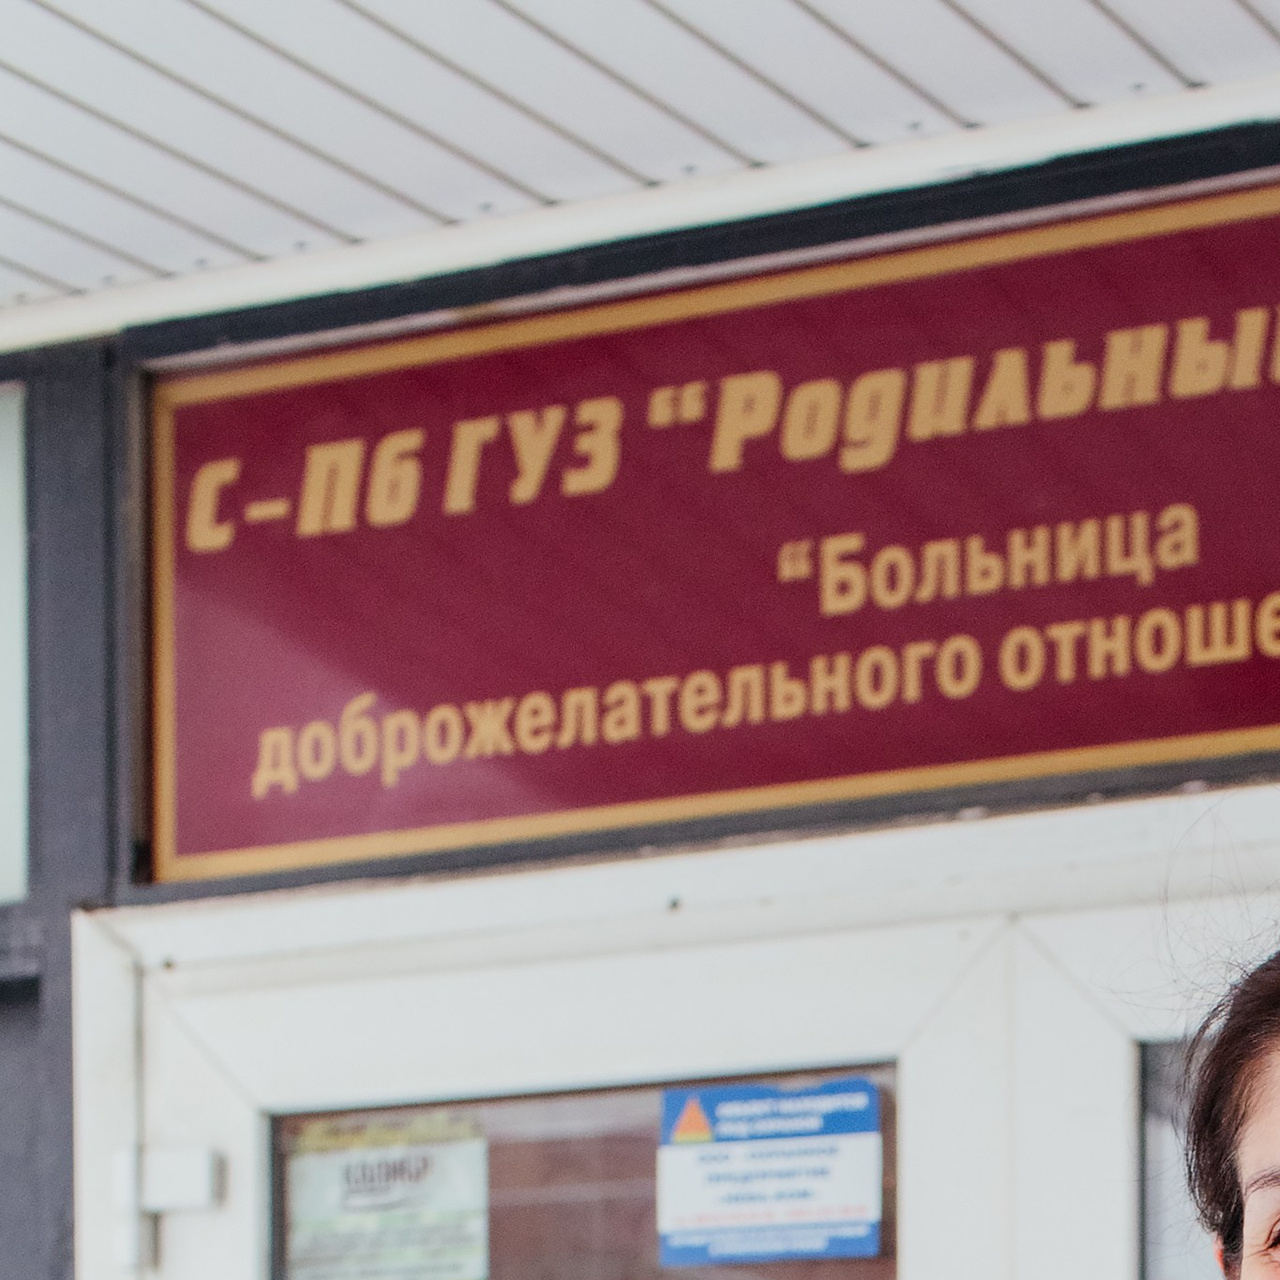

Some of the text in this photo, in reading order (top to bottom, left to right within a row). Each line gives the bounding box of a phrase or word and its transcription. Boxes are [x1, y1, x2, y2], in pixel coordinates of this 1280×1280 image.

[442, 396, 624, 515] ГУЗ
[777, 502, 1200, 617] “Больница
[250, 633, 984, 802] доброжелательного
